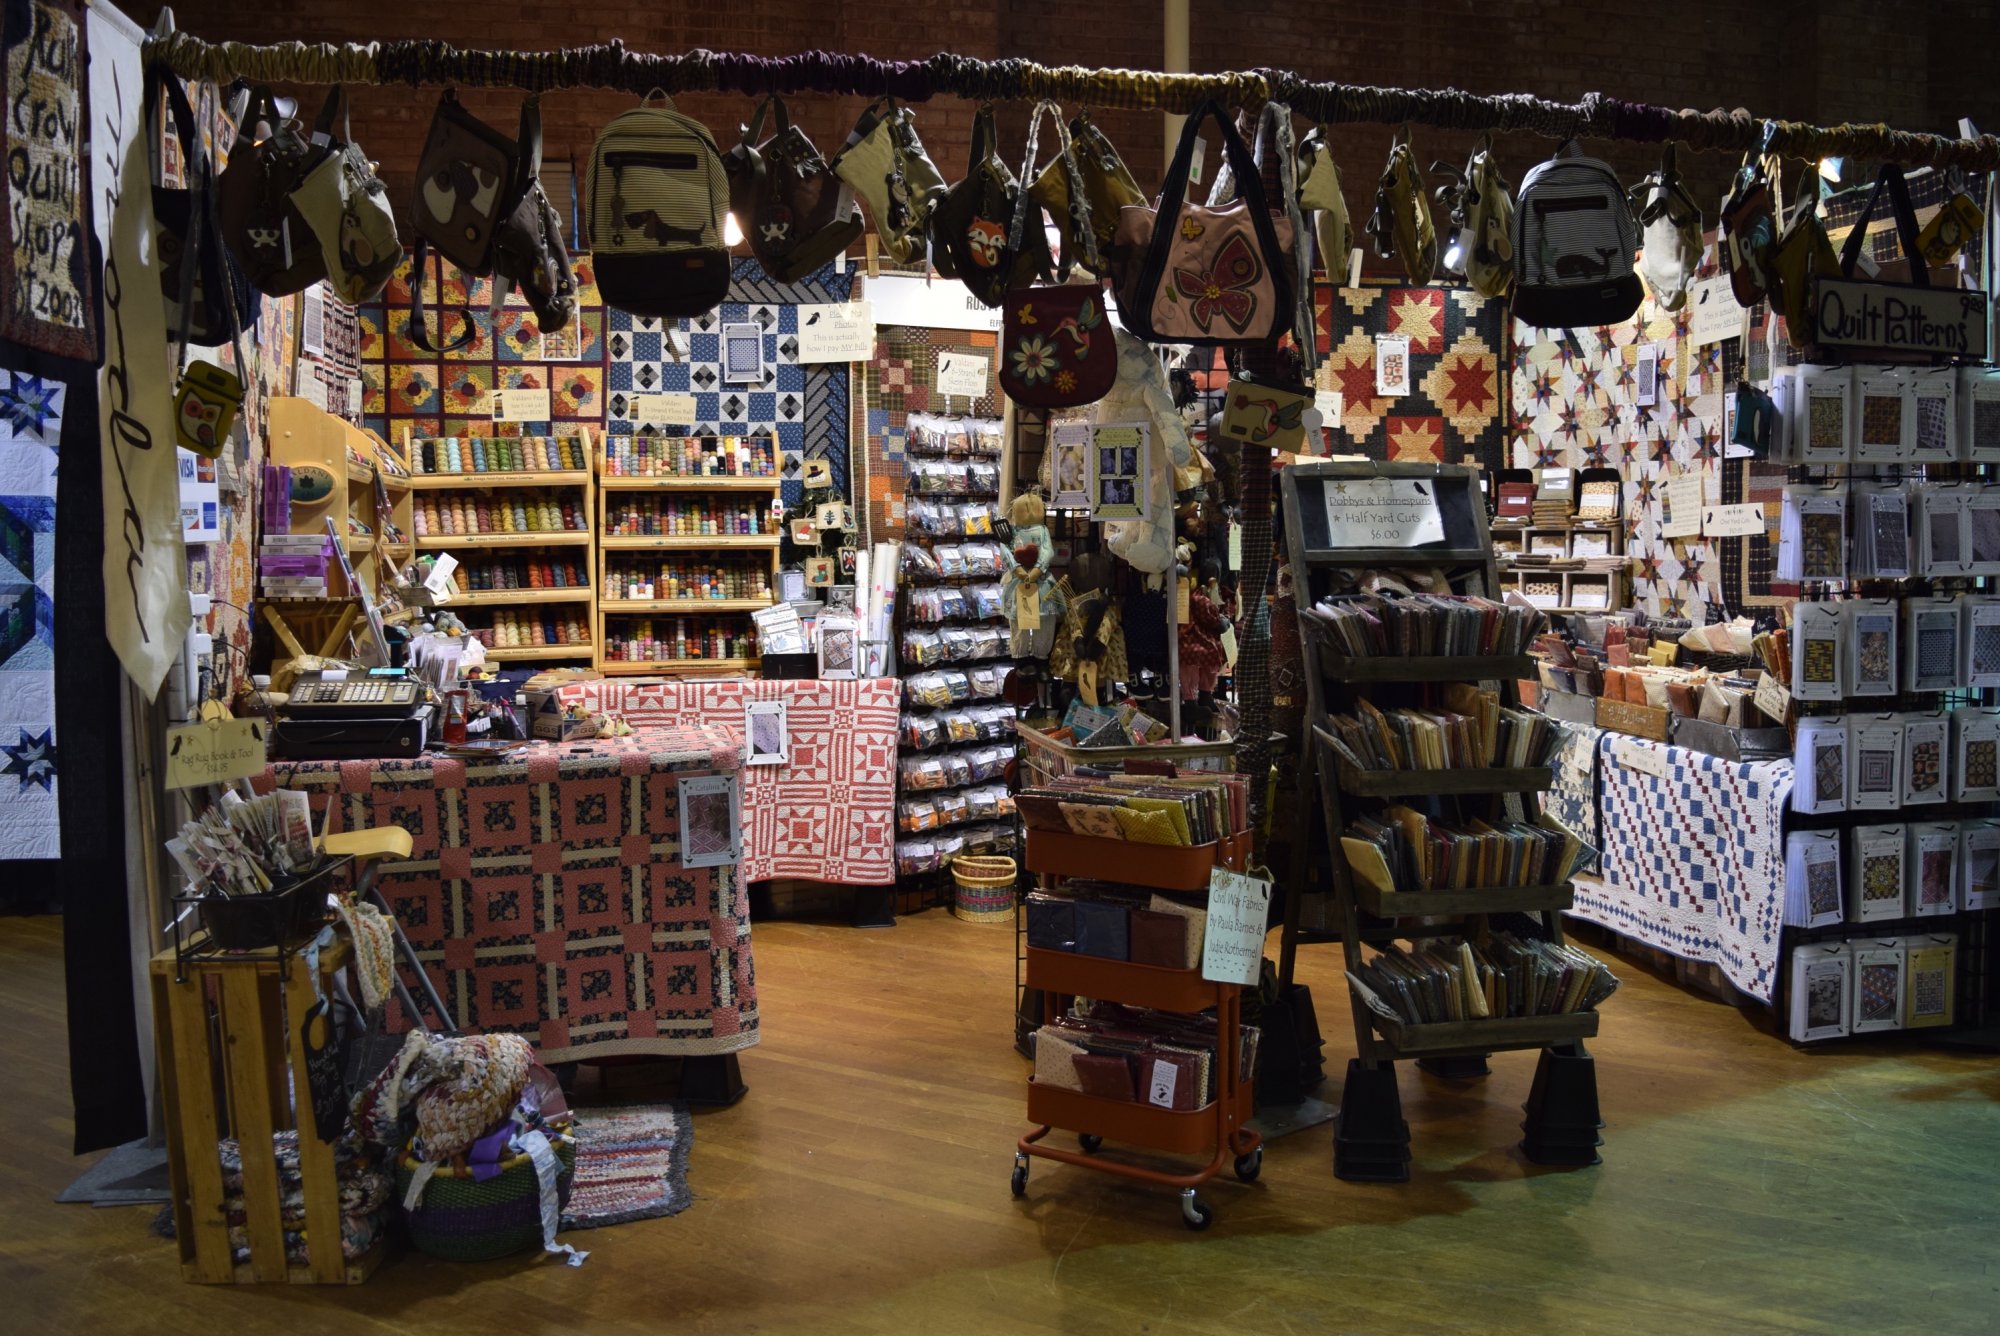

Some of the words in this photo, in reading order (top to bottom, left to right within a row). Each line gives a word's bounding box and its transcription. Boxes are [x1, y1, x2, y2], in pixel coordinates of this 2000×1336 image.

[8, 147, 77, 218] Quilt
[13, 200, 65, 272] Shop
[966, 295, 998, 311] RUS
[1820, 289, 1883, 342] Quilt
[1885, 297, 1968, 353] Patterns
[105, 61, 152, 644] moda
[179, 457, 195, 478] VISA
[291, 468, 329, 480] ALDANI
[1329, 496, 1364, 508] Dobbys
[1367, 497, 1375, 506] &
[1377, 496, 1433, 508] Homespuns
[1346, 511, 1369, 523] Half
[1370, 513, 1394, 523] Yard
[1397, 513, 1421, 523] Cuts
[1371, 529, 1400, 541] $6.00
[535, 726, 557, 735] GGS
[211, 751, 229, 761] Book
[238, 744, 254, 759] Tool
[1213, 889, 1227, 904] Civil
[1242, 896, 1264, 912] Fabrics
[1218, 914, 1233, 931] Paula
